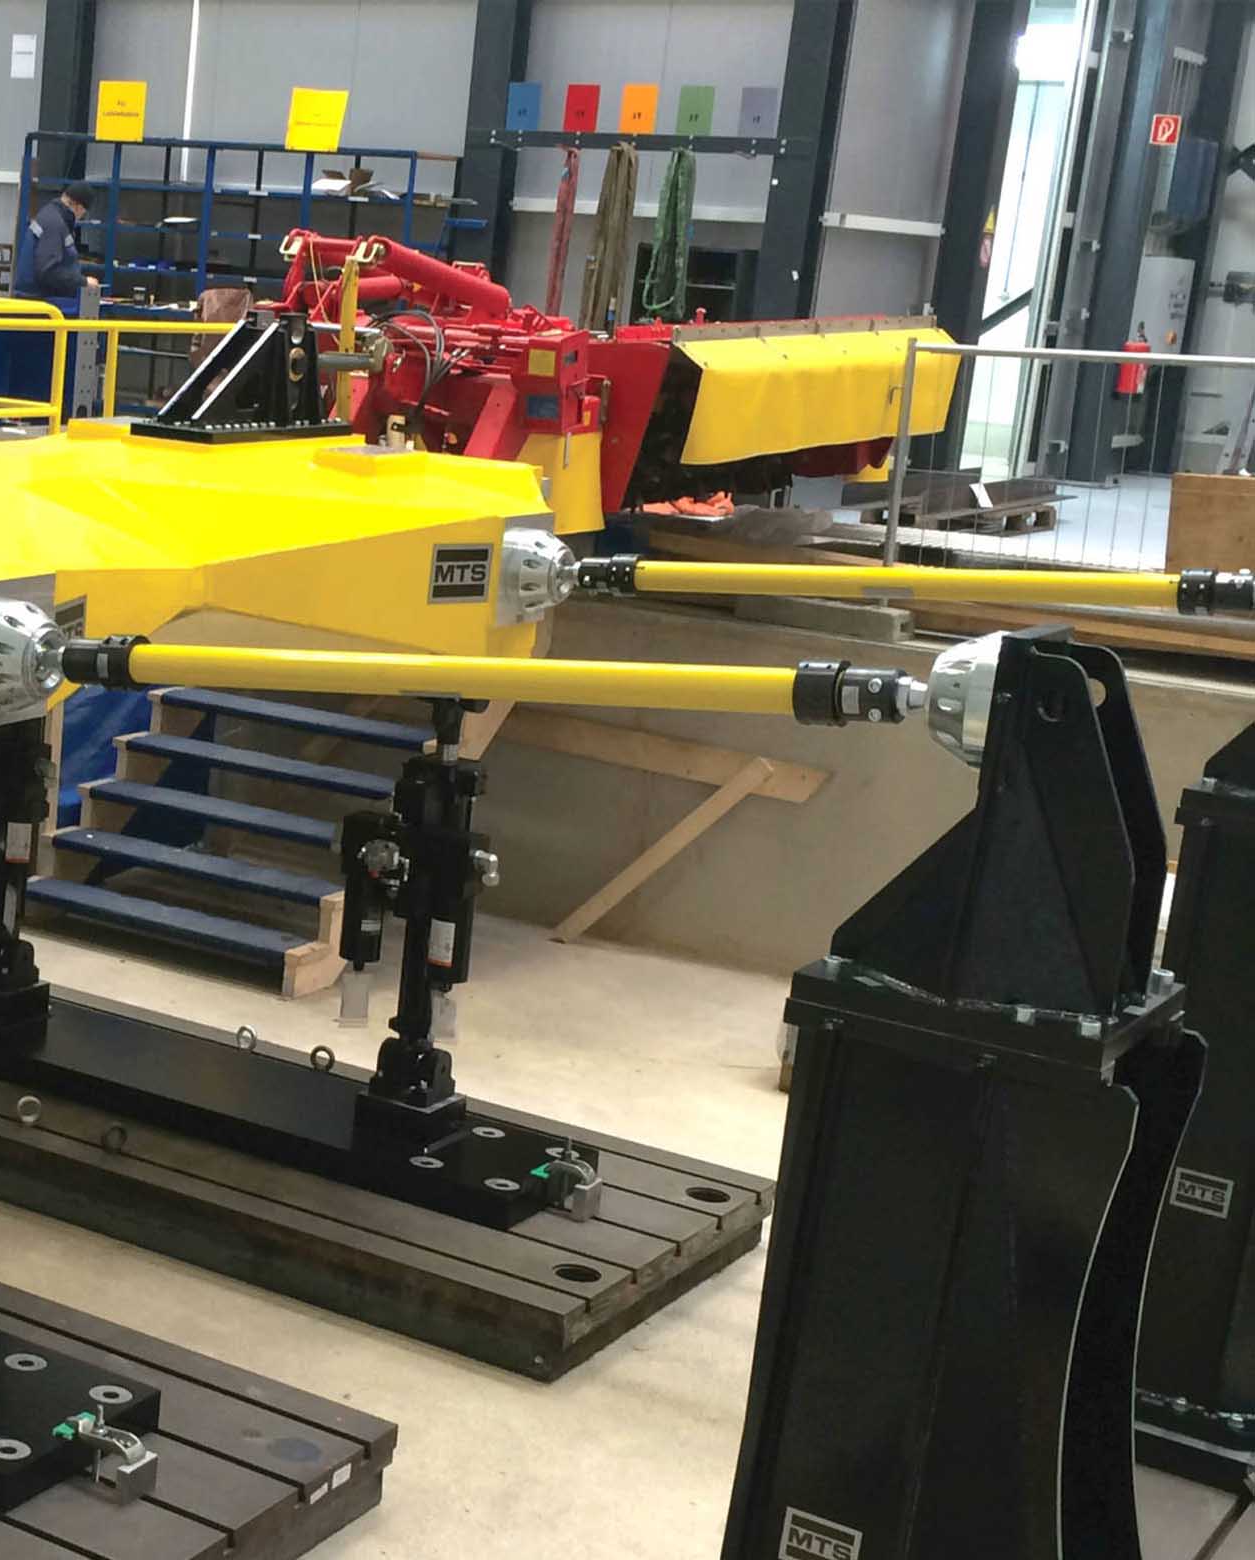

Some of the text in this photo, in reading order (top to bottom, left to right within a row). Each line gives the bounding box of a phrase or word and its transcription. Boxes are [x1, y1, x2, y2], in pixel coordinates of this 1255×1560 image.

[434, 564, 486, 583] MTS
[1177, 1181, 1226, 1203] MTS
[788, 1527, 851, 1560] MTS
